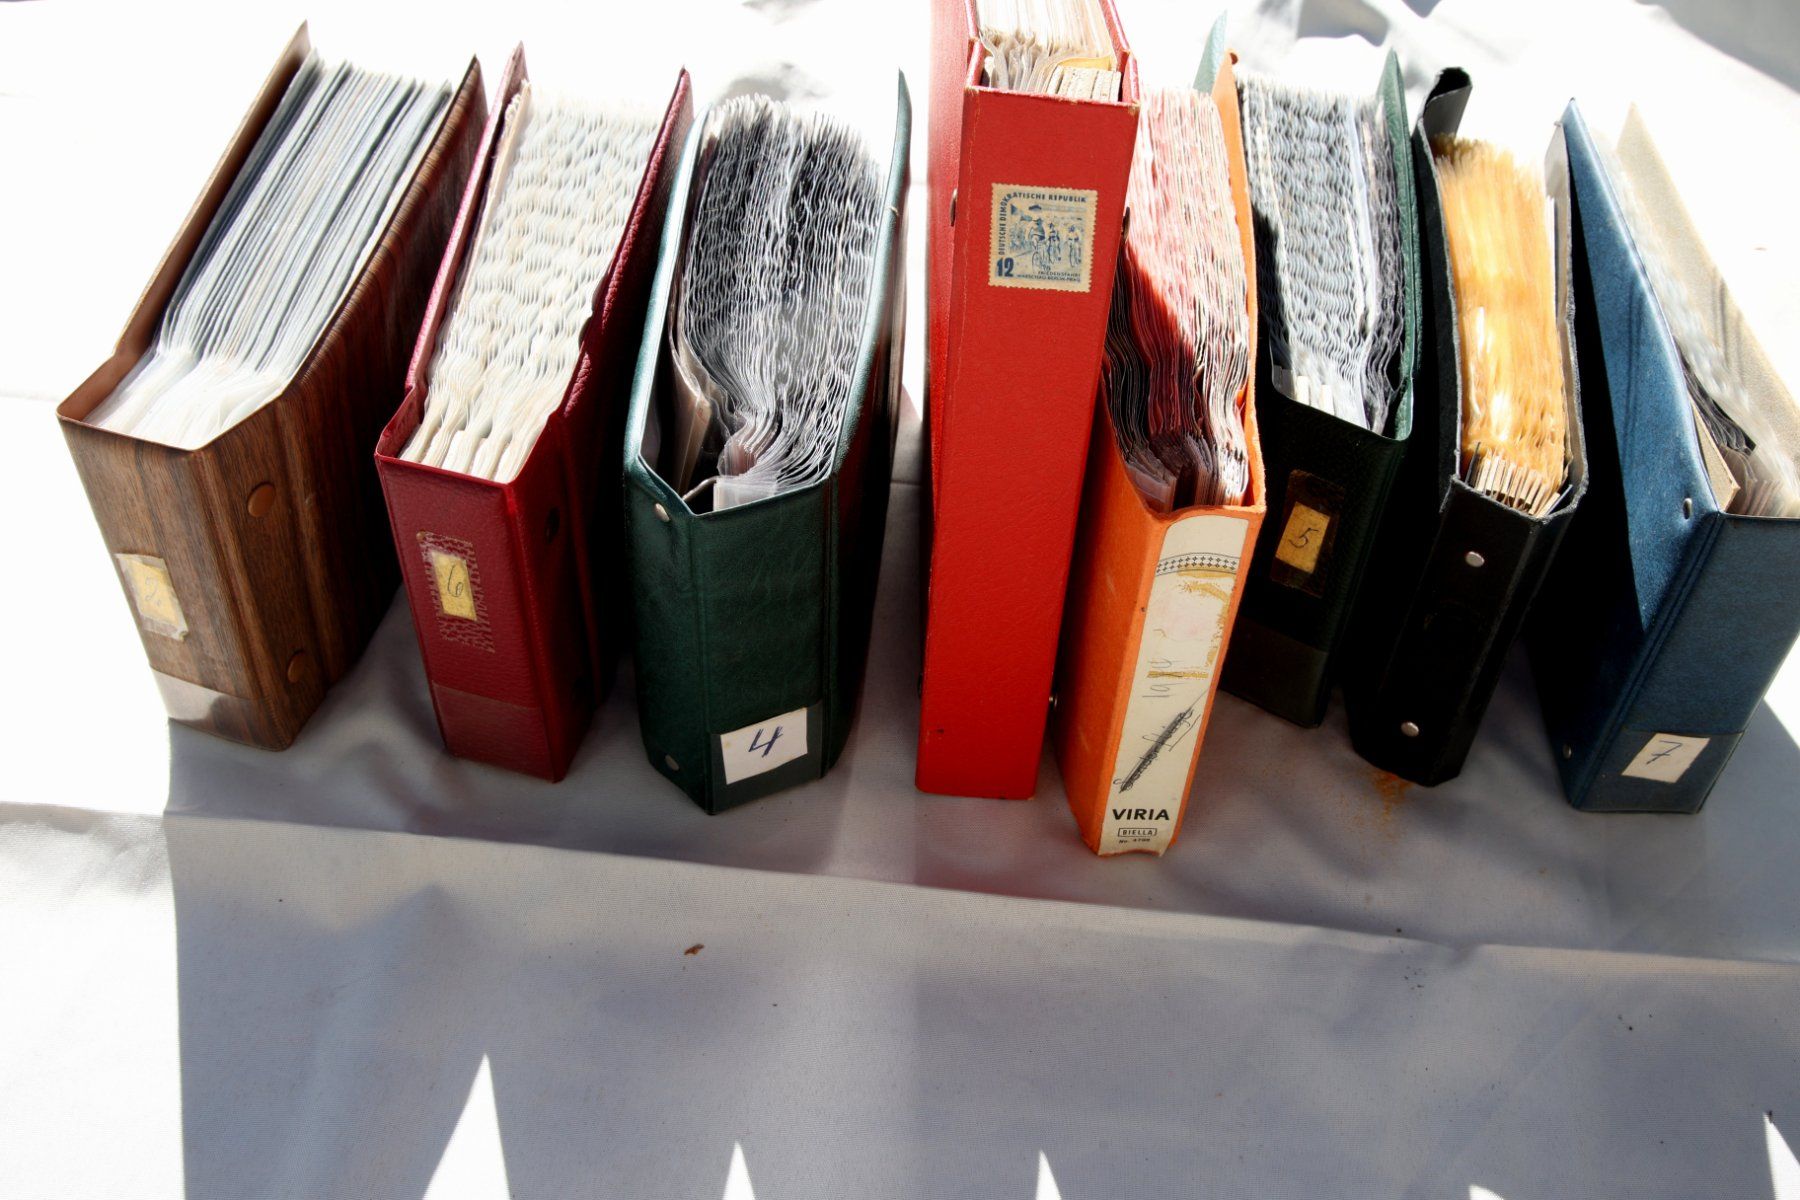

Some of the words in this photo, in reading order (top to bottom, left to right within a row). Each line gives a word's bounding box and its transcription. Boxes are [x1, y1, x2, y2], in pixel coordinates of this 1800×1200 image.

[998, 223, 1006, 255] DEUTSCHE
[1048, 193, 1087, 203] REPUBLIK
[996, 257, 1014, 277] 12
[1288, 527, 1320, 549] 5
[447, 563, 464, 598] 6
[748, 726, 784, 758] 4
[1645, 740, 1684, 765] 7
[1112, 808, 1170, 821] VIRIA
